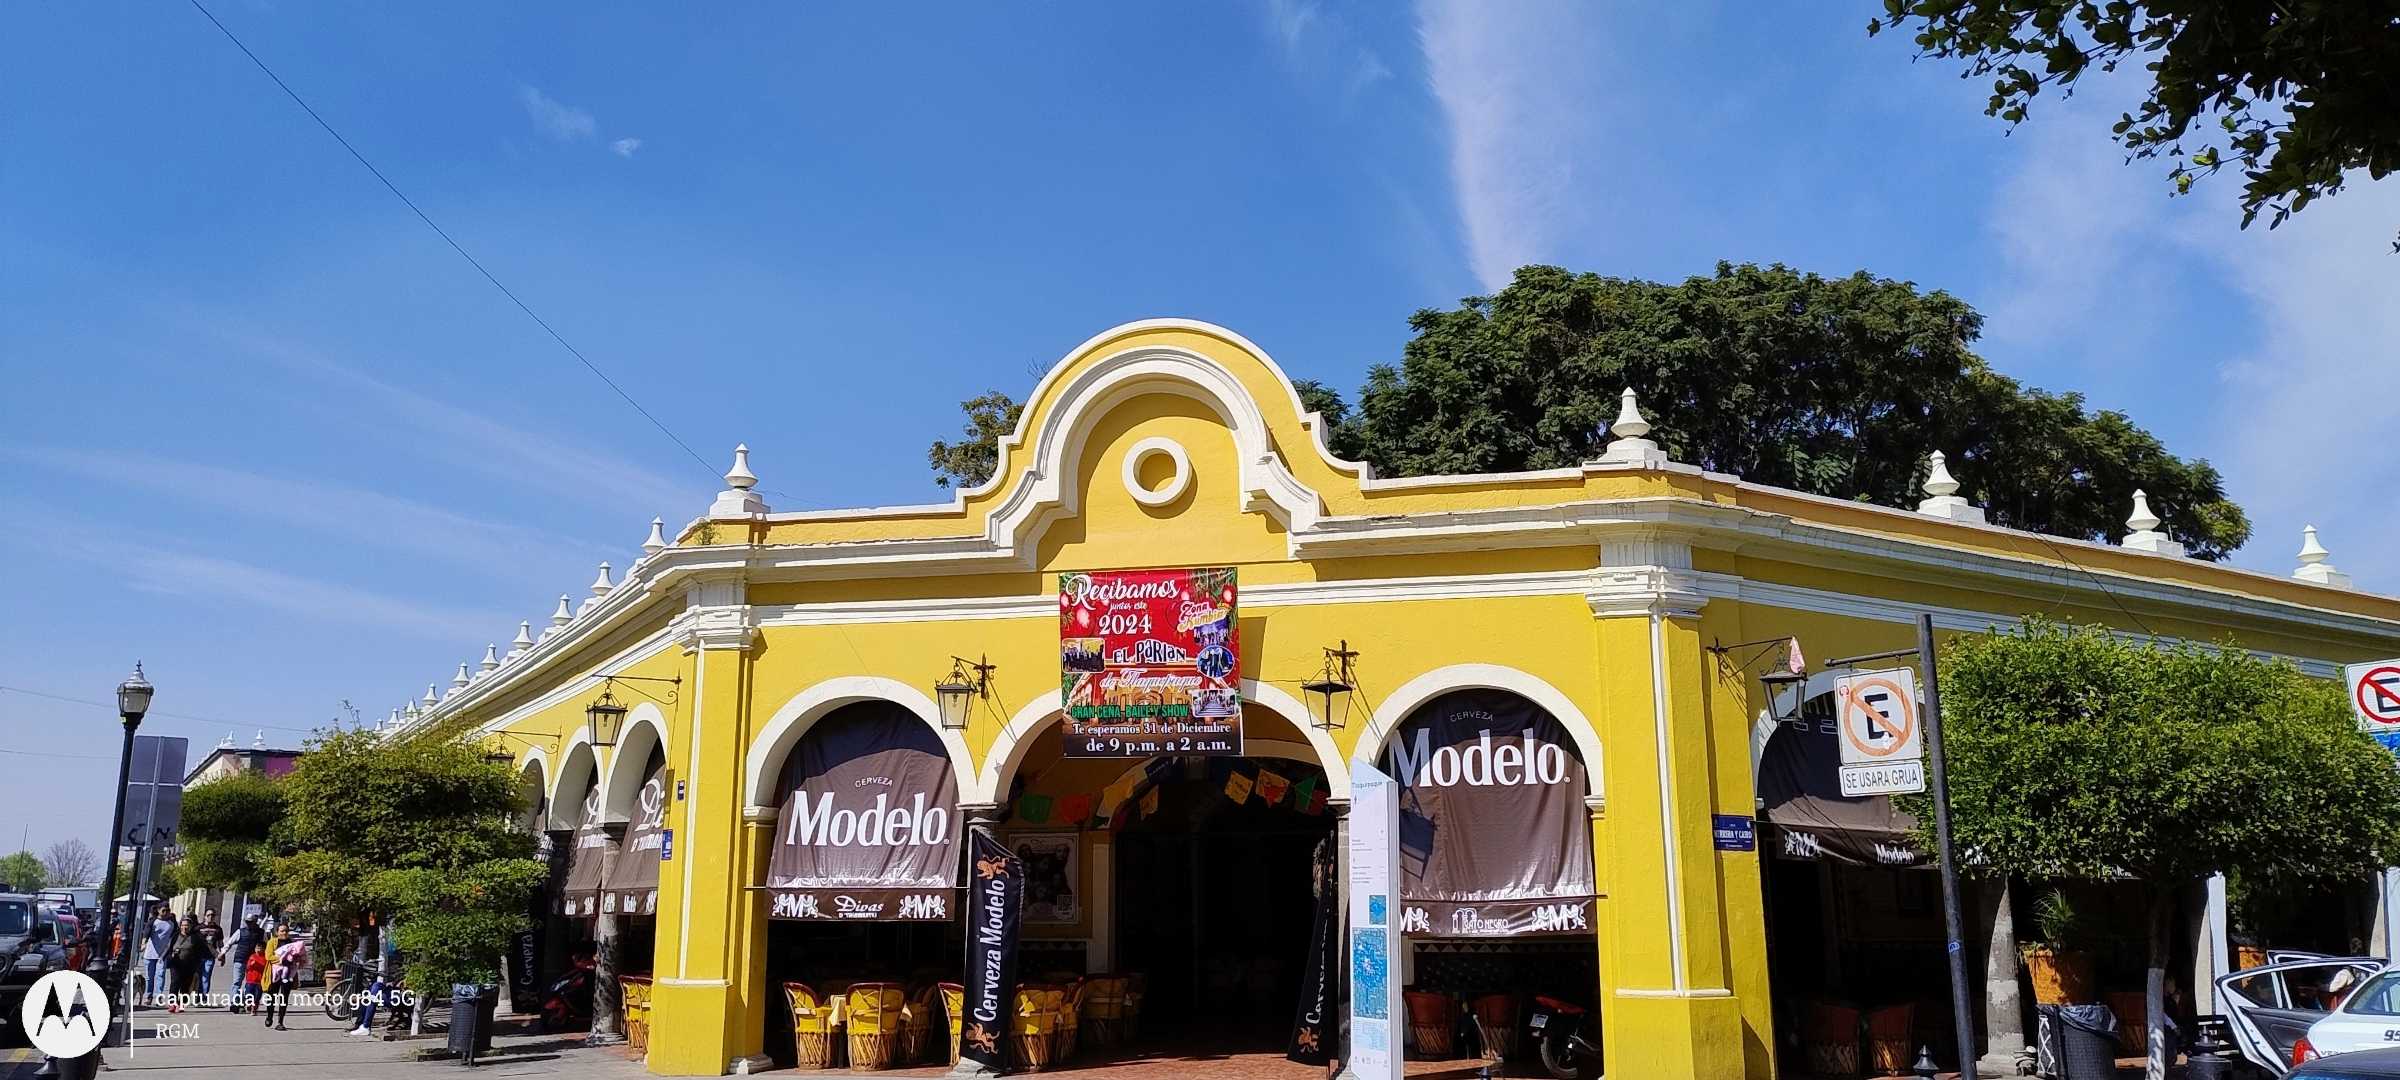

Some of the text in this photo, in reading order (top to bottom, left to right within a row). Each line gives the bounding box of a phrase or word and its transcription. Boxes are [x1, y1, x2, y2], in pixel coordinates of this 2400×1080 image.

[1066, 575, 1180, 610] Recibamos
[1099, 615, 1152, 635] 2024
[1072, 704, 1096, 718] GRAN
[1162, 704, 1189, 717] SHOW
[1450, 711, 1493, 723] CERVEZA
[1072, 722, 1231, 737] Te esperamos 31 de Diciembre
[1086, 737, 1231, 756] de 9 p.m. a 2 a.m.
[1388, 727, 1565, 788] Modelo
[855, 776, 893, 788] CERVEZA
[1845, 768, 1919, 788] SE USARA GRUA
[786, 790, 947, 846] Modelo
[834, 895, 884, 912] Divas
[974, 878, 1005, 1022] Cerveza Modelo
